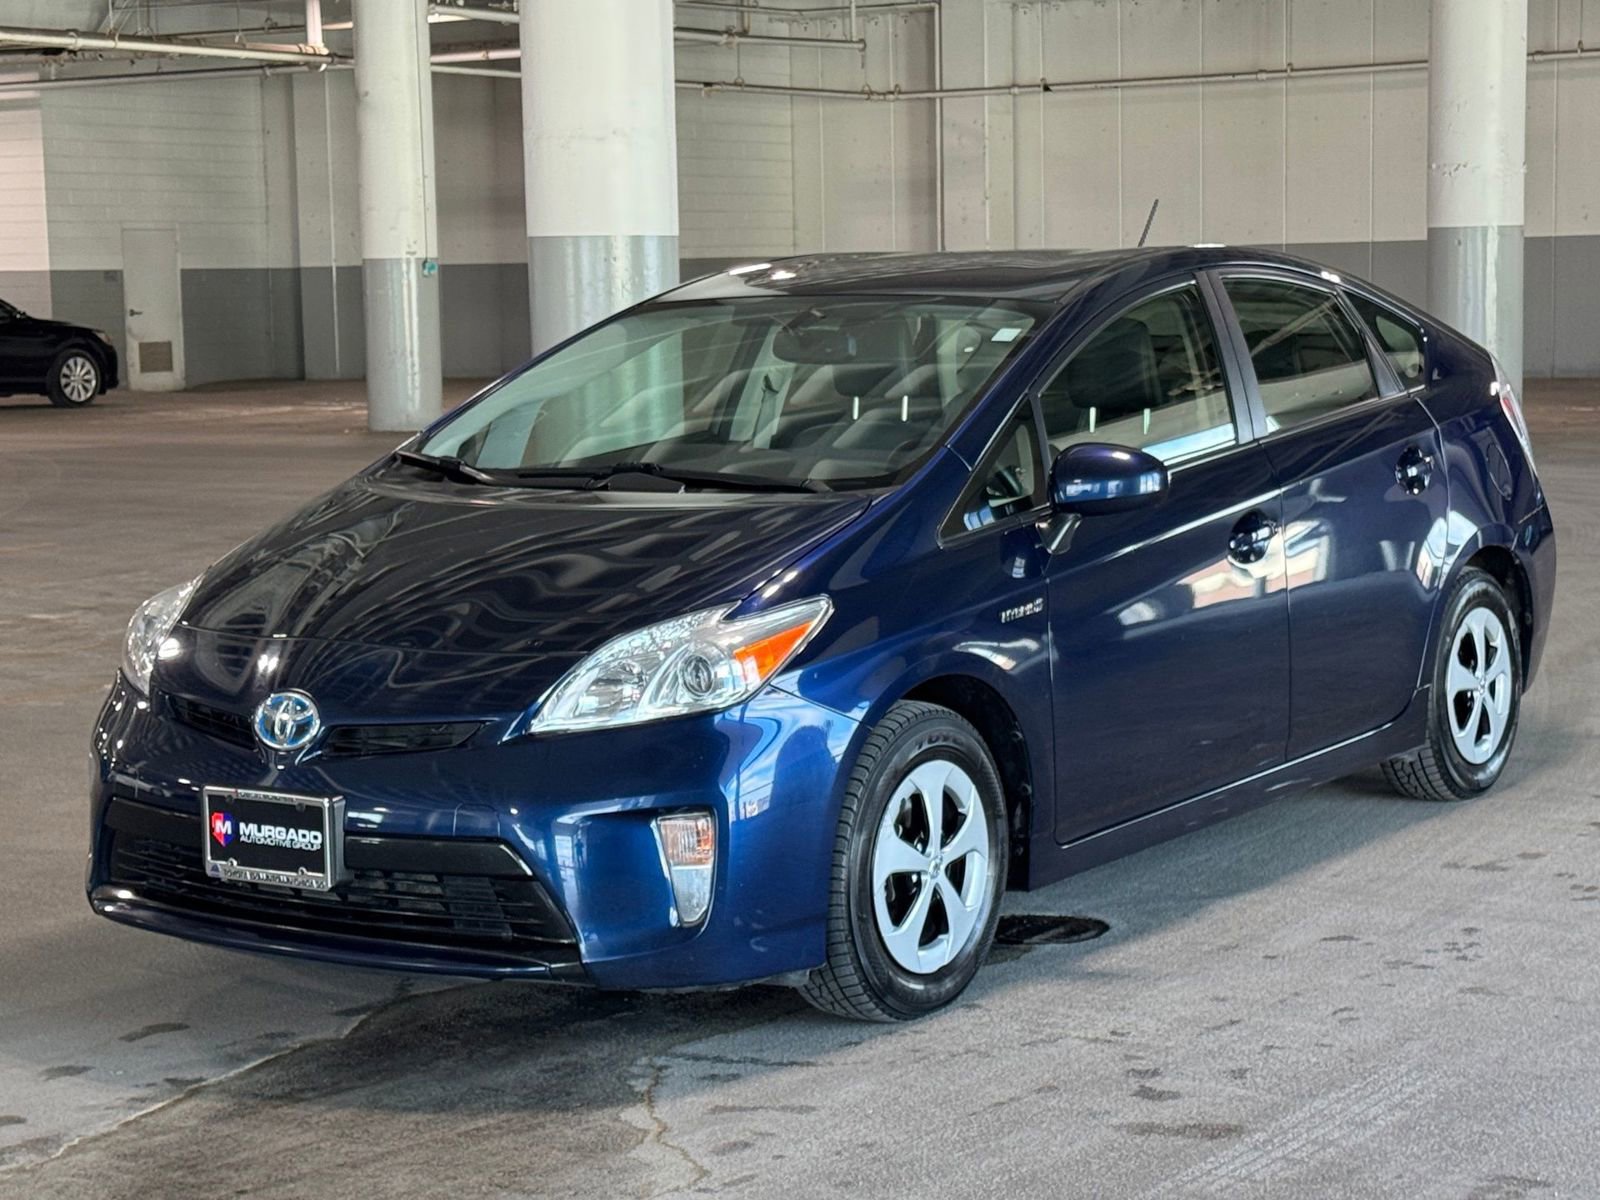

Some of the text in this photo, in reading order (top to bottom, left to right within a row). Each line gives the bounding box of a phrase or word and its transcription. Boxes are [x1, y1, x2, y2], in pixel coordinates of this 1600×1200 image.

[214, 820, 232, 835] M
[239, 822, 323, 844] MURGADO
[240, 835, 321, 851] AUTOMOTIVE GROUP
